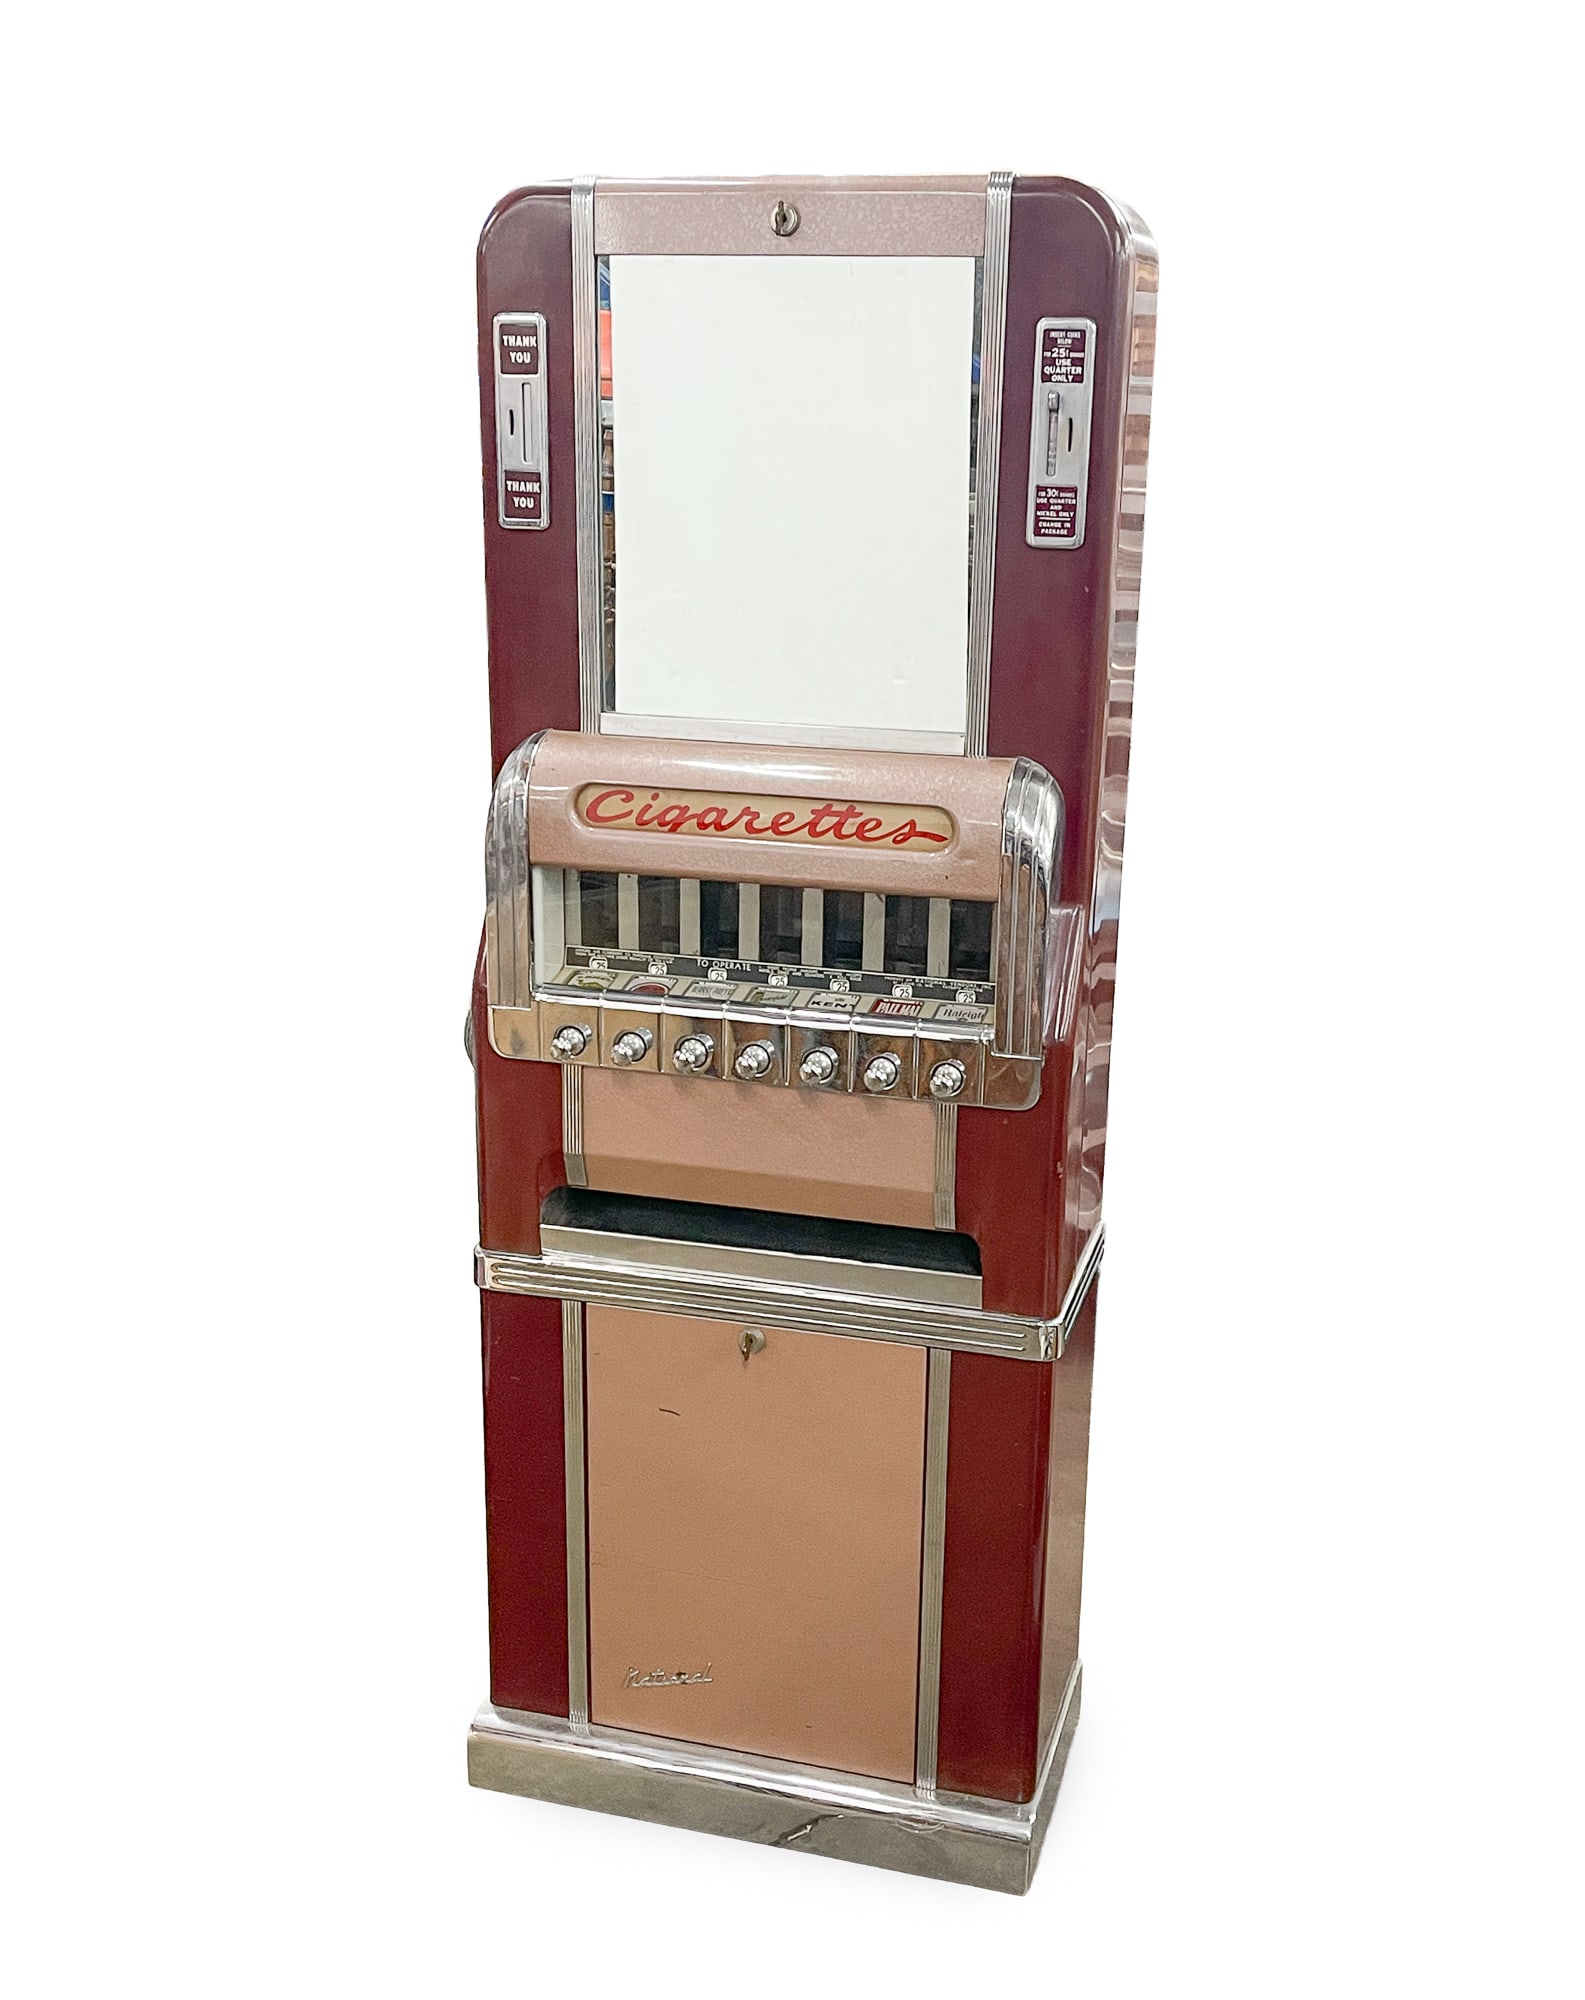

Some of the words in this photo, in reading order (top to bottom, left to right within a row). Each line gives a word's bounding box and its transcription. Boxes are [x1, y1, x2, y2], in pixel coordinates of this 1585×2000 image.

[502, 335, 537, 347] THANK
[509, 351, 531, 363] YOU
[1055, 358, 1071, 366] USE
[1043, 366, 1082, 375] QUARTER
[506, 480, 541, 493] THANK
[512, 496, 534, 509] YOU
[585, 788, 949, 845] Cigarettes
[655, 964, 665, 975] 25
[697, 959, 709, 968] TO
[713, 961, 751, 971] OPERATE
[714, 972, 724, 981] 25
[774, 977, 785, 986] 25
[836, 982, 847, 992] 25
[898, 988, 910, 998] 25
[962, 993, 974, 1004] 25
